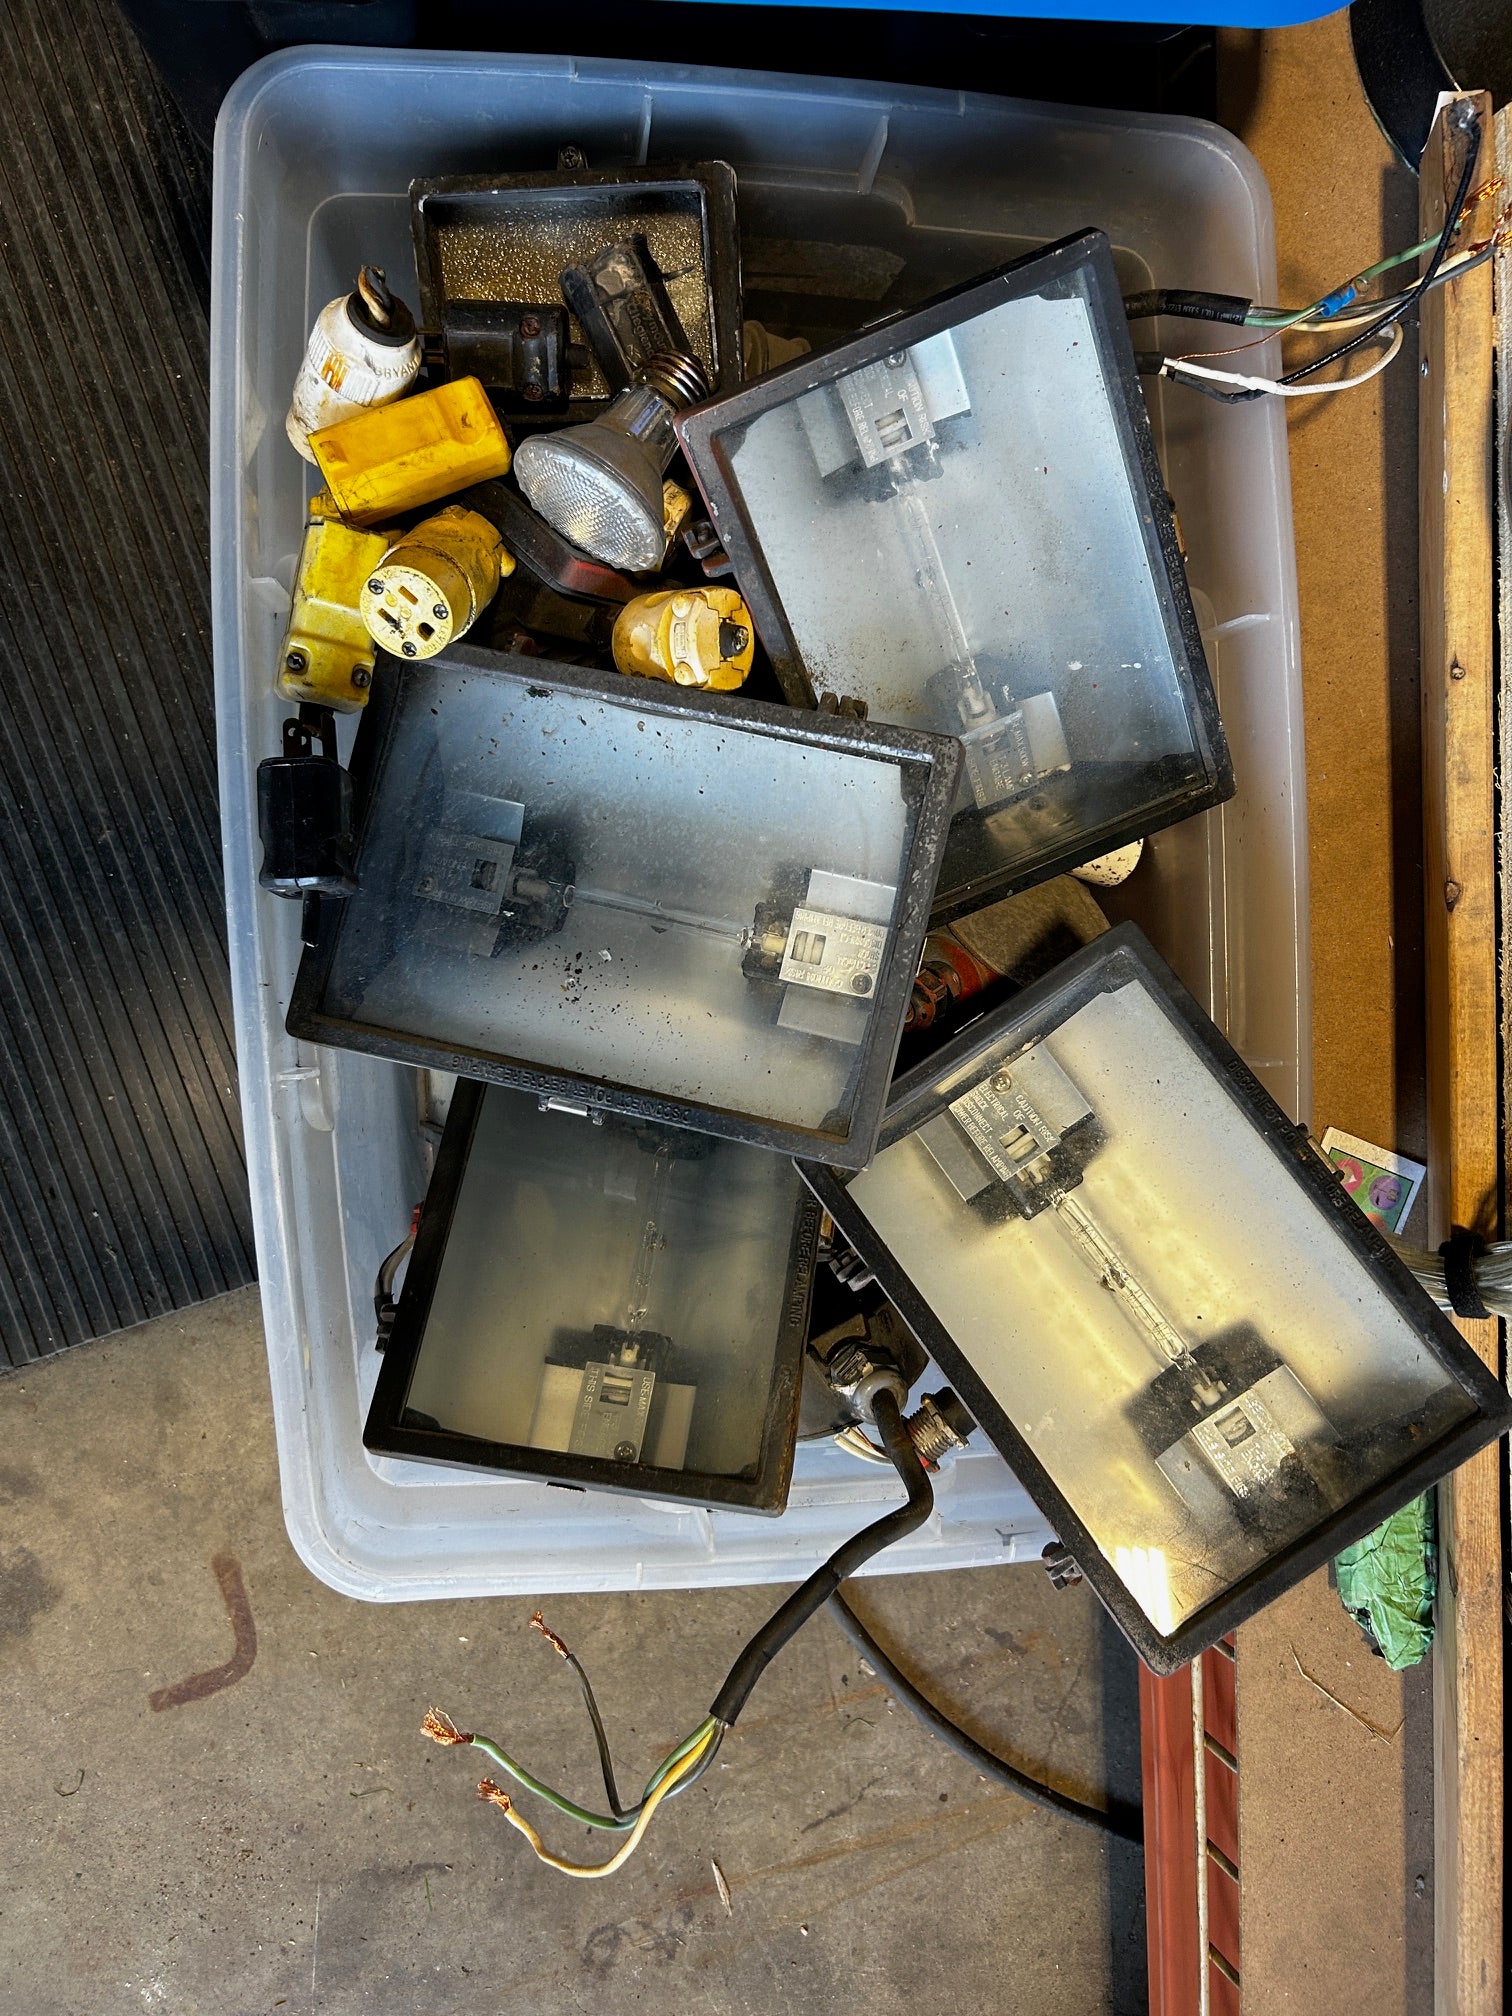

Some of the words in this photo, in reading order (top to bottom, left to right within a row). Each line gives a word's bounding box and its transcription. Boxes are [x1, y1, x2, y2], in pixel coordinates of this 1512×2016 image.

[895, 388, 909, 403] OF
[820, 962, 835, 975] OF
[448, 1053, 522, 1084] RELAMPING
[520, 1069, 569, 1095] BEFORE
[570, 1081, 615, 1106] POWER
[969, 1088, 989, 1112] SHOCK
[977, 1082, 1010, 1122] ELECTRICAL
[614, 1091, 692, 1124] DISCONNECT
[960, 1094, 993, 1135] DISCONNECT
[1011, 1108, 1025, 1123] OF
[1014, 1093, 1043, 1127] CAUTION
[1037, 1124, 1056, 1145] RISK
[951, 1100, 974, 1127] POWER
[967, 1122, 989, 1147] BEFORE
[982, 1142, 1013, 1179] RELAMPING
[1225, 1059, 1282, 1127] DISCONNECT
[1308, 1163, 1348, 1208] BEFORE
[797, 1210, 817, 1257] BEFORE
[786, 1256, 811, 1328] RELAMPING
[584, 1366, 599, 1393] THIS
[639, 1376, 652, 1396] USE
[580, 1393, 593, 1418] SIDE
[635, 1395, 647, 1417] MAX
